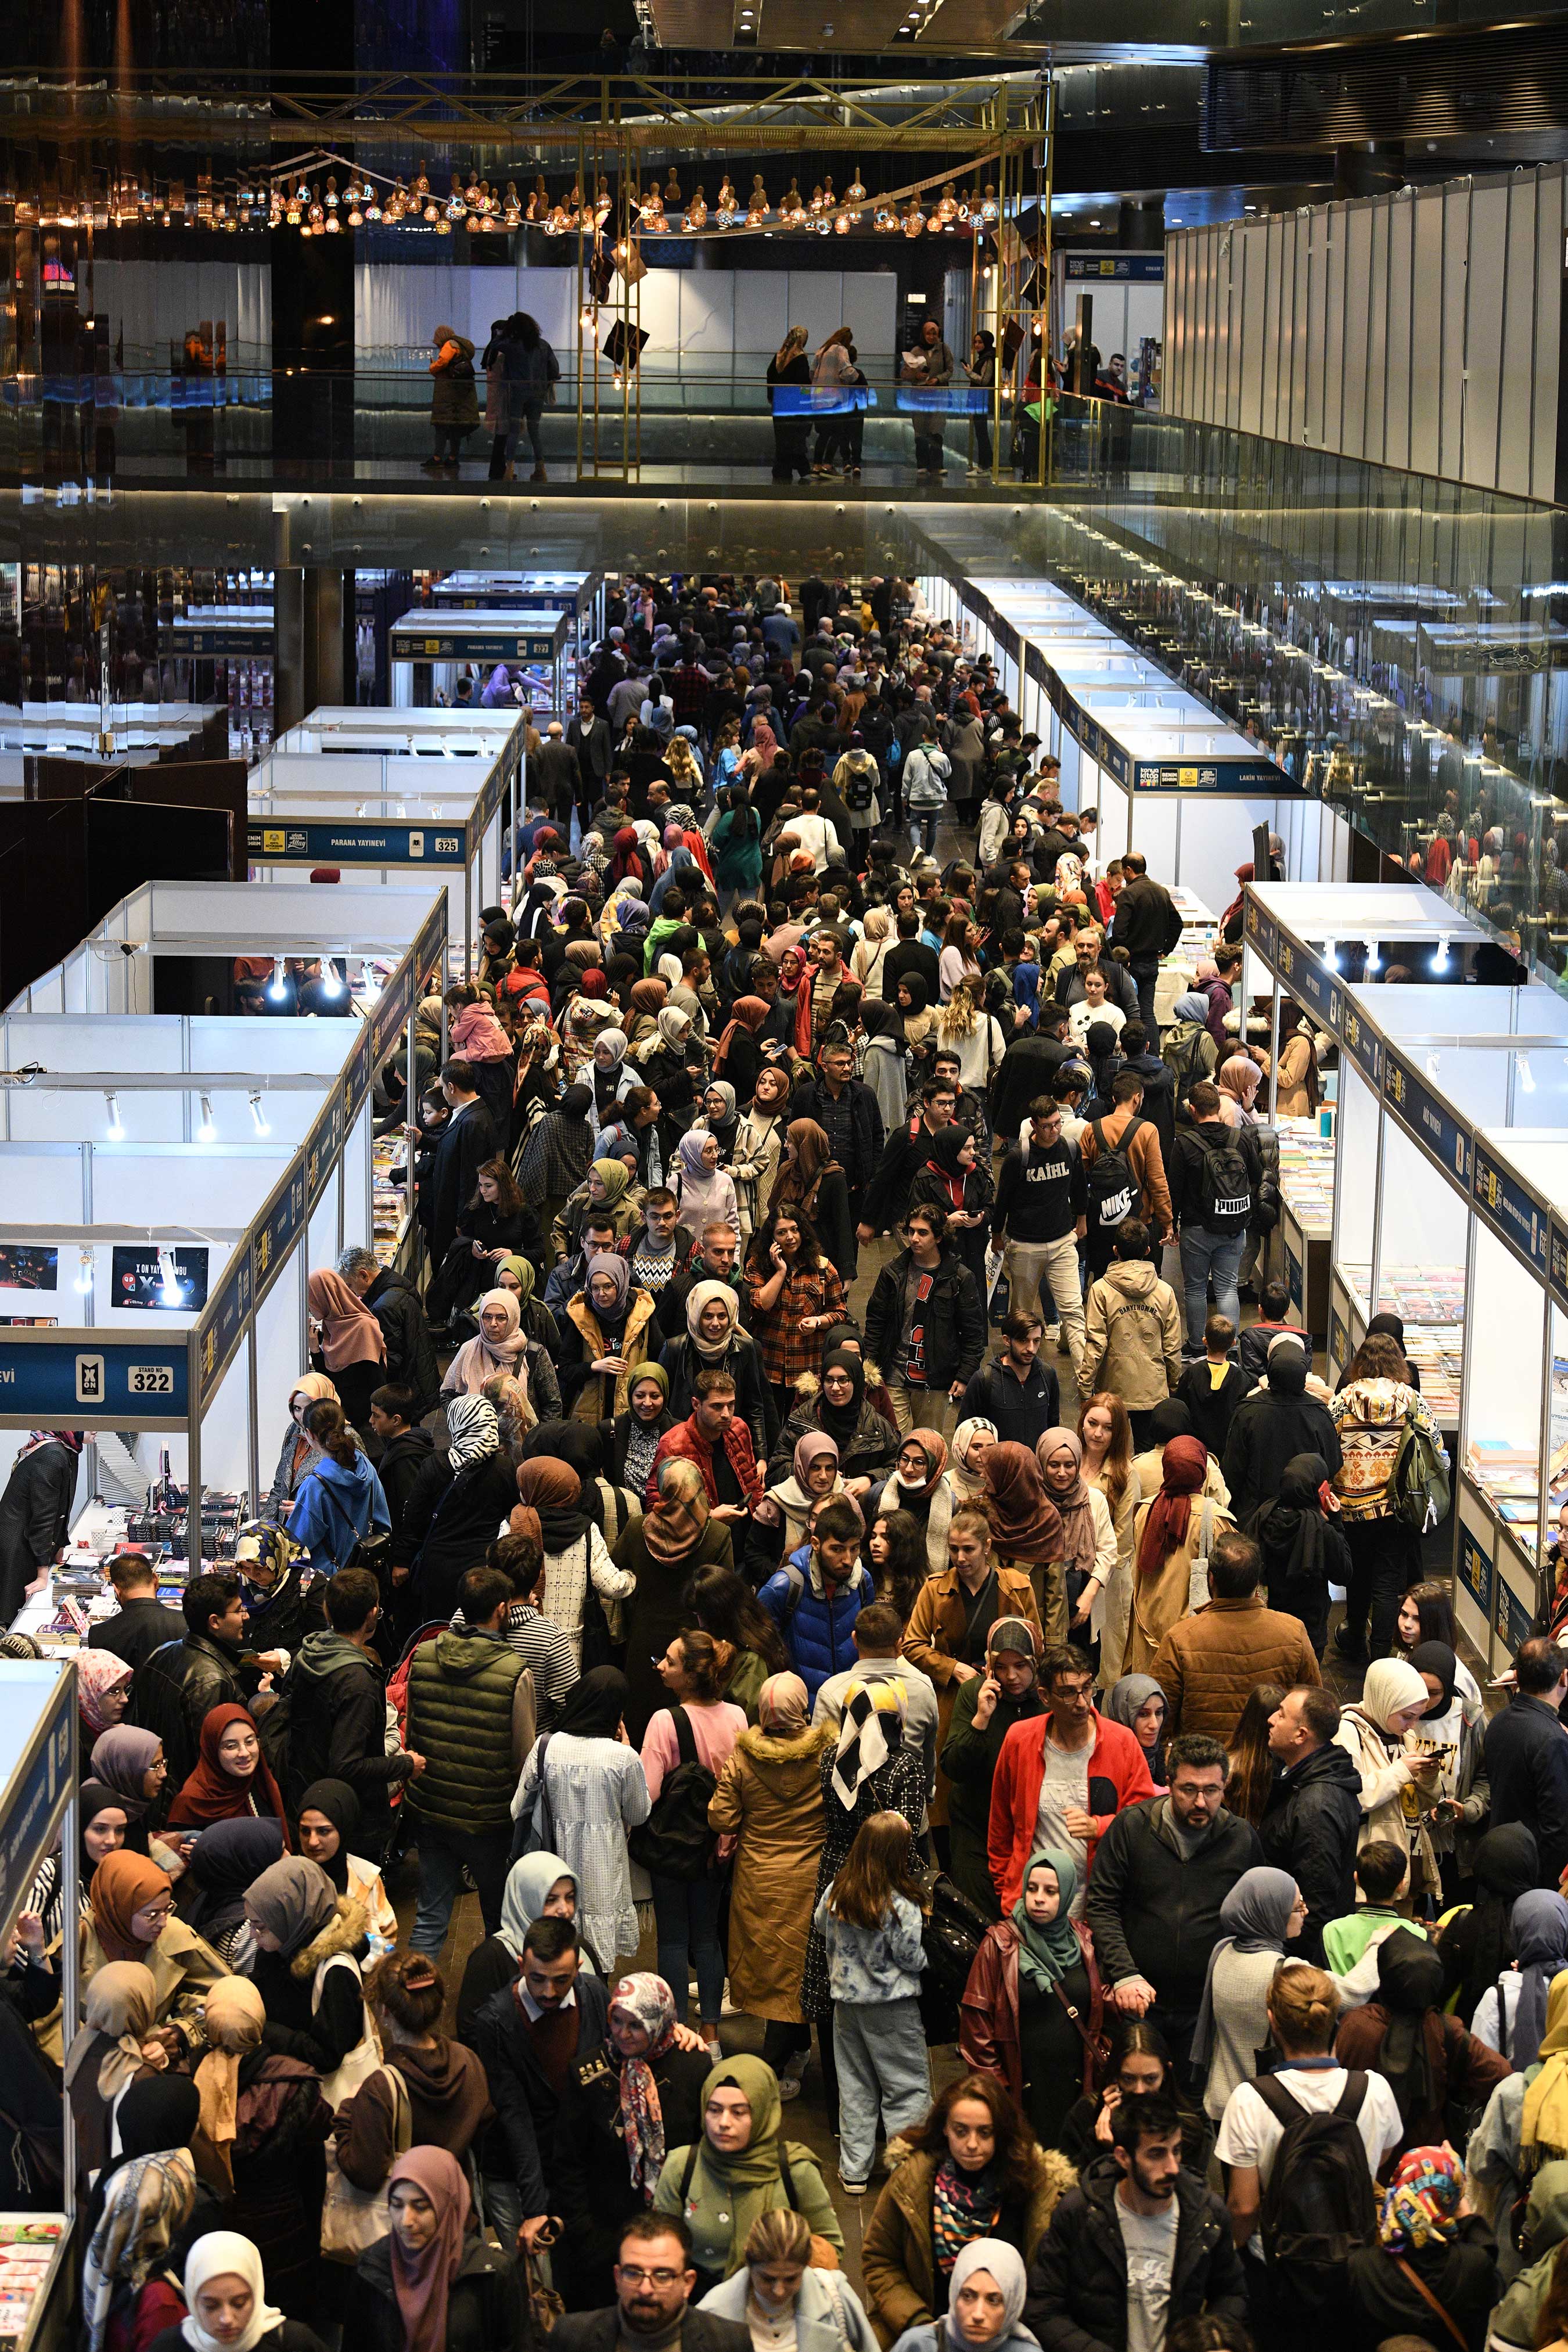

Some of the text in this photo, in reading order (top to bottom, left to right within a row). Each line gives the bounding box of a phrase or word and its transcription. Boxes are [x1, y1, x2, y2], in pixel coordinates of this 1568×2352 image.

[288, 840, 306, 848] Altay
[358, 839, 386, 847] YAYINEVİ
[438, 842, 456, 851] 325
[1026, 1161, 1070, 1182] KAİHL
[1101, 1186, 1131, 1218] NIKE
[1219, 1196, 1249, 1213] PUMA
[136, 1264, 140, 1273] X
[142, 1265, 149, 1274] ON
[84, 1369, 96, 1382] X
[134, 1373, 169, 1391] 322
